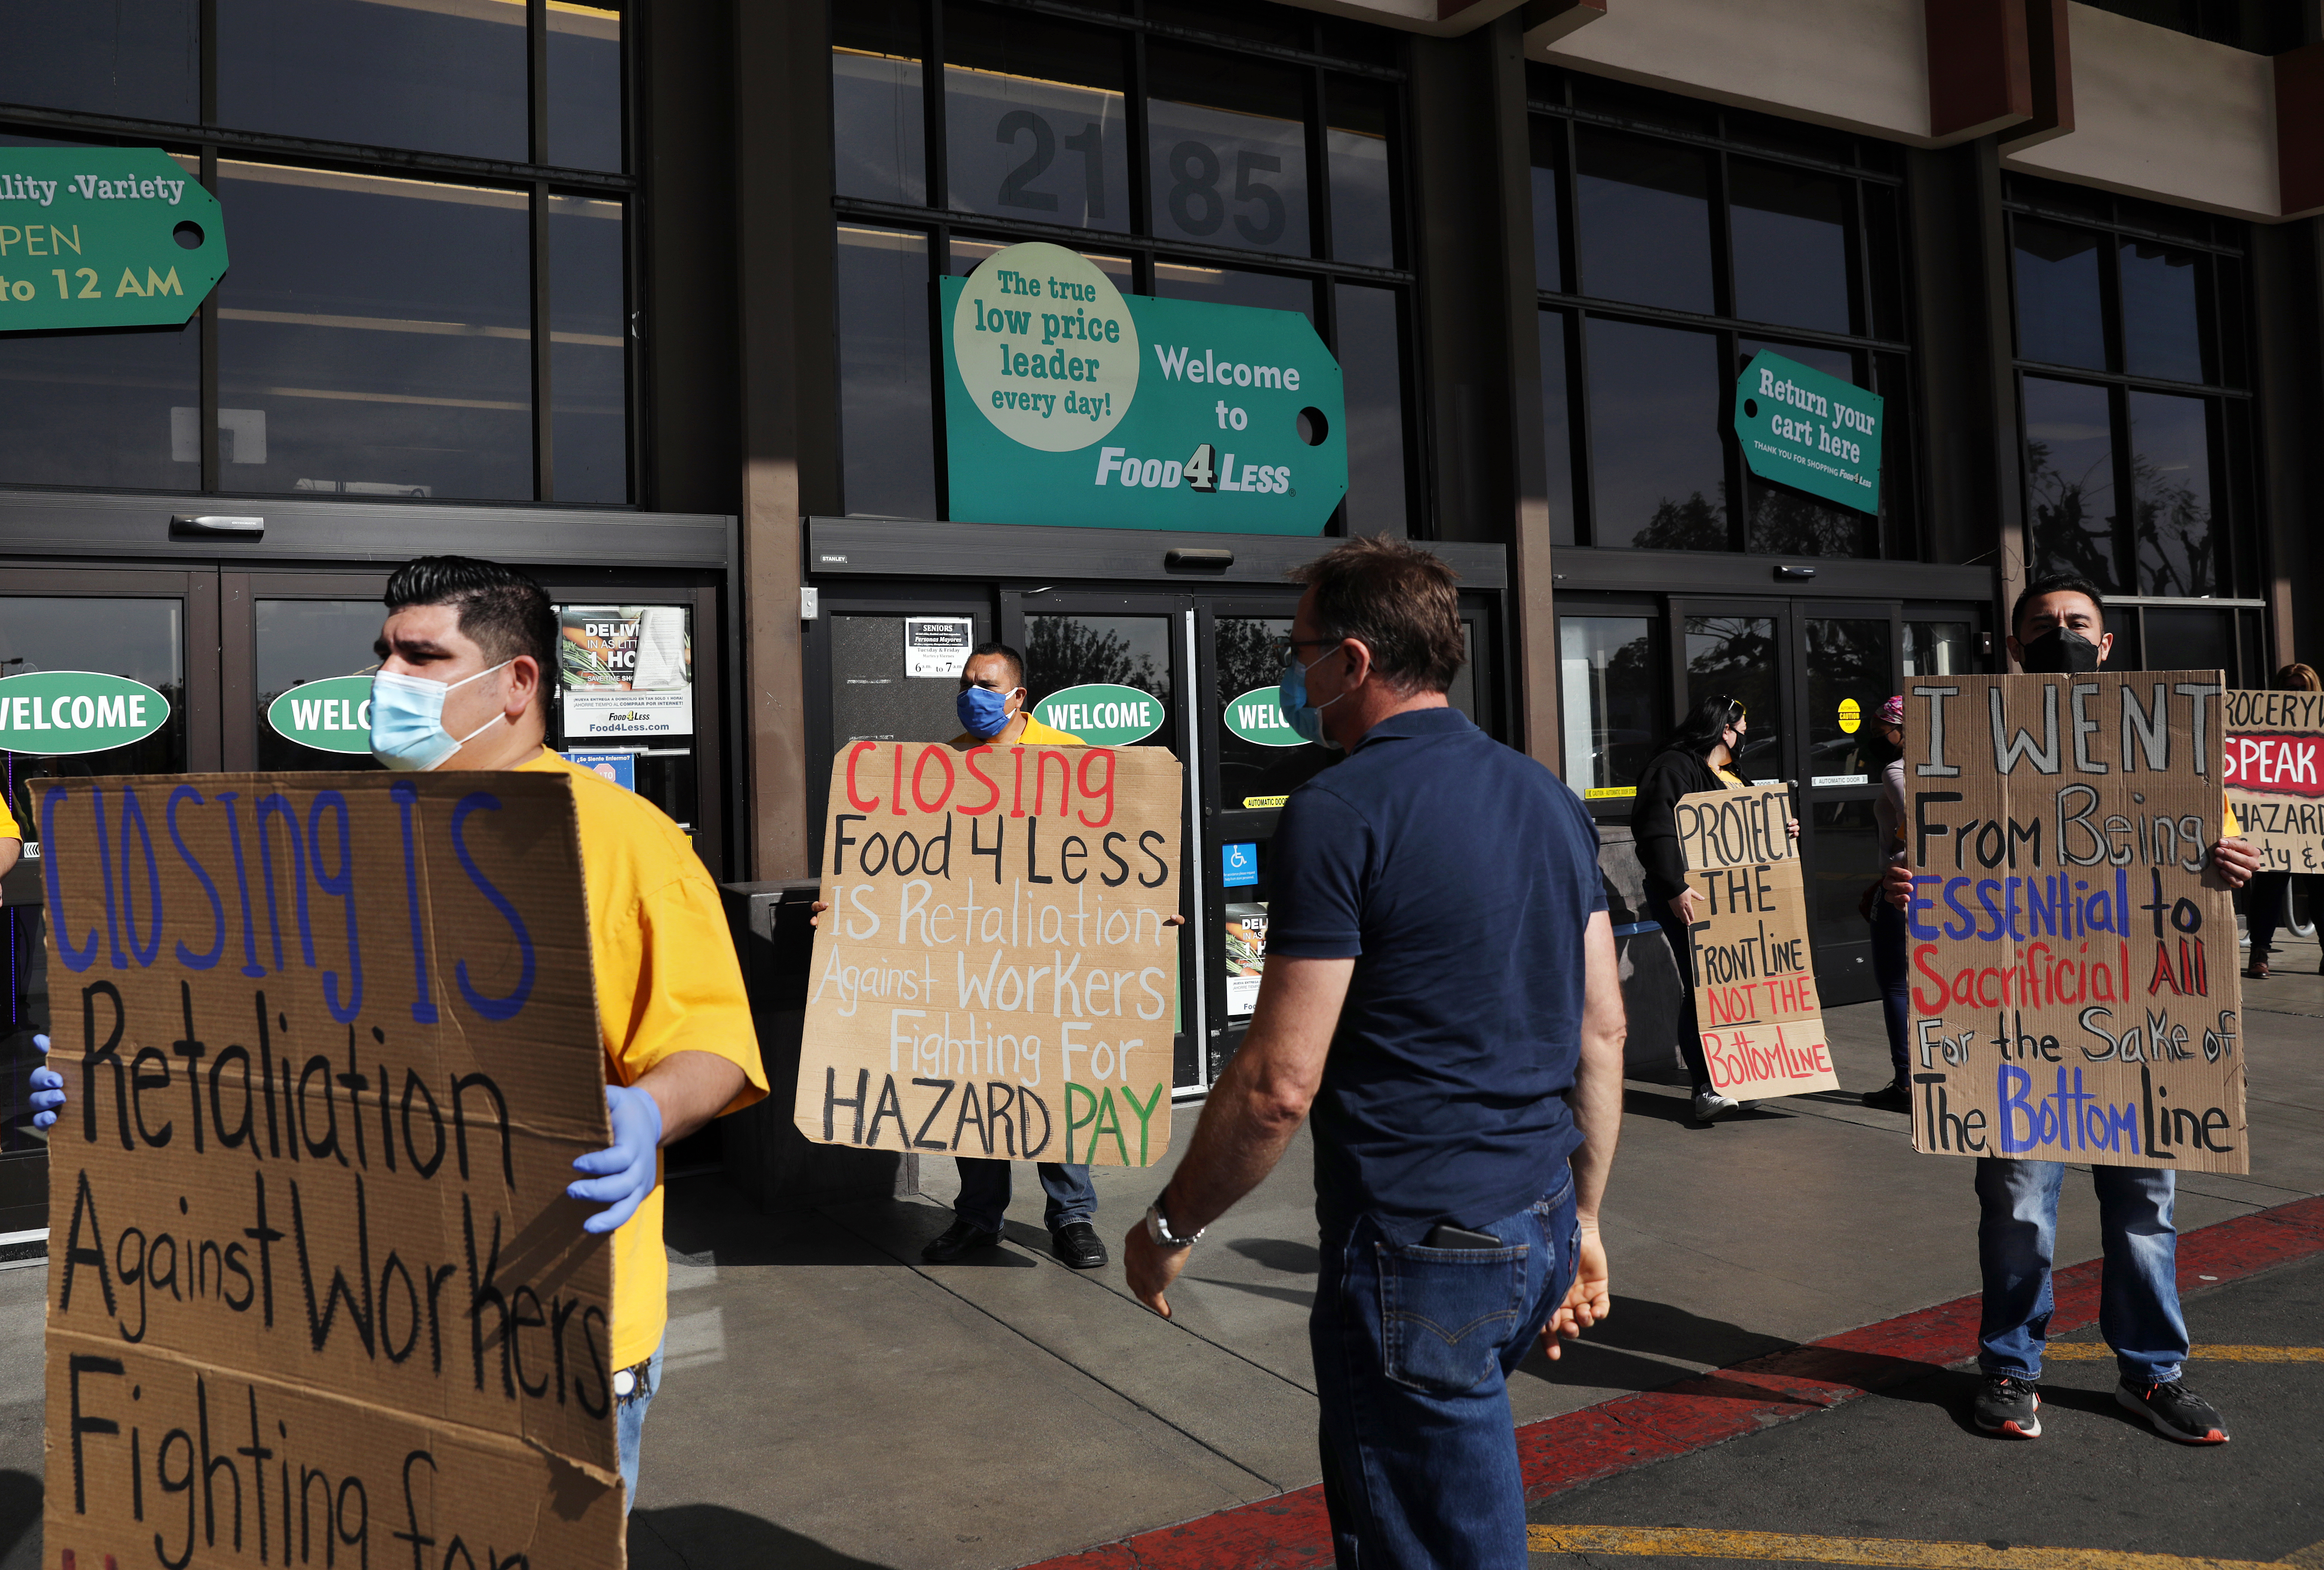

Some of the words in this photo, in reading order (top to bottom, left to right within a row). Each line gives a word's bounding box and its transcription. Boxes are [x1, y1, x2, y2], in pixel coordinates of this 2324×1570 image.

[0, 173, 57, 206] lity
[0, 225, 81, 256] PEN
[0, 275, 35, 301] to
[52, 267, 101, 299] 12
[115, 266, 184, 297] AM
[998, 270, 1041, 297] The
[1048, 276, 1096, 302] true
[974, 299, 1031, 335] low
[1042, 309, 1119, 345] price
[1000, 343, 1099, 382] leader
[1154, 344, 1300, 391] Welcome
[992, 390, 1056, 418] every
[1064, 391, 1111, 422] day!
[1216, 400, 1248, 431] to
[1759, 368, 1827, 418] Return
[1832, 402, 1875, 436] your
[1754, 440, 1777, 455] THANK
[1778, 448, 1792, 460] YOU
[1793, 454, 1806, 465] FOR
[1807, 459, 1838, 476] SHOPPING
[1772, 414, 1812, 446] cart
[1818, 425, 1860, 464] here
[587, 640, 598, 649] IN
[601, 640, 615, 648] AS
[588, 651, 598, 668] 1
[608, 650, 635, 668] HO
[915, 663, 921, 672] 6
[946, 662, 952, 672] 7
[291, 699, 371, 731] WELC
[590, 723, 669, 732] Food4Less.com
[1047, 702, 1151, 730] WELCOME
[1238, 704, 1290, 730] WELC
[1912, 684, 1960, 777] I
[1989, 682, 2222, 776] WENT
[2224, 737, 2317, 784] SPEAK
[834, 811, 951, 880] Food
[971, 814, 1003, 885] 4
[1028, 815, 1169, 887] Less
[1676, 792, 1792, 871] PROTECT
[2056, 783, 2210, 874] Being
[391, 780, 536, 1024] IS
[829, 884, 880, 941] IS
[898, 877, 1161, 947] Retaliation
[1700, 865, 1775, 915] THE
[2140, 867, 2202, 938] to
[1242, 918, 1268, 930] DELI
[1243, 932, 1251, 940] IN
[1252, 931, 1263, 939] AS
[1243, 942, 1250, 956] 1
[812, 943, 939, 1017] Against
[1912, 941, 2130, 1015] Sacrificial
[2147, 936, 2208, 997] All
[1708, 983, 1757, 1025] NOT
[1763, 976, 1814, 1015] THE
[890, 1009, 1041, 1087] Fighting
[1061, 1022, 1143, 1081] For
[1916, 1018, 1975, 1069] For
[1990, 1010, 2062, 1062] the
[2203, 1010, 2236, 1064] of
[82, 980, 515, 1193] Retaliation
[823, 1065, 1054, 1160] HAZARD
[1064, 1082, 1163, 1166] PAY
[1913, 1073, 1986, 1153] The
[2140, 1064, 2235, 1160] Line
[59, 1169, 285, 1342] Against
[70, 1353, 368, 1570] Fighting
